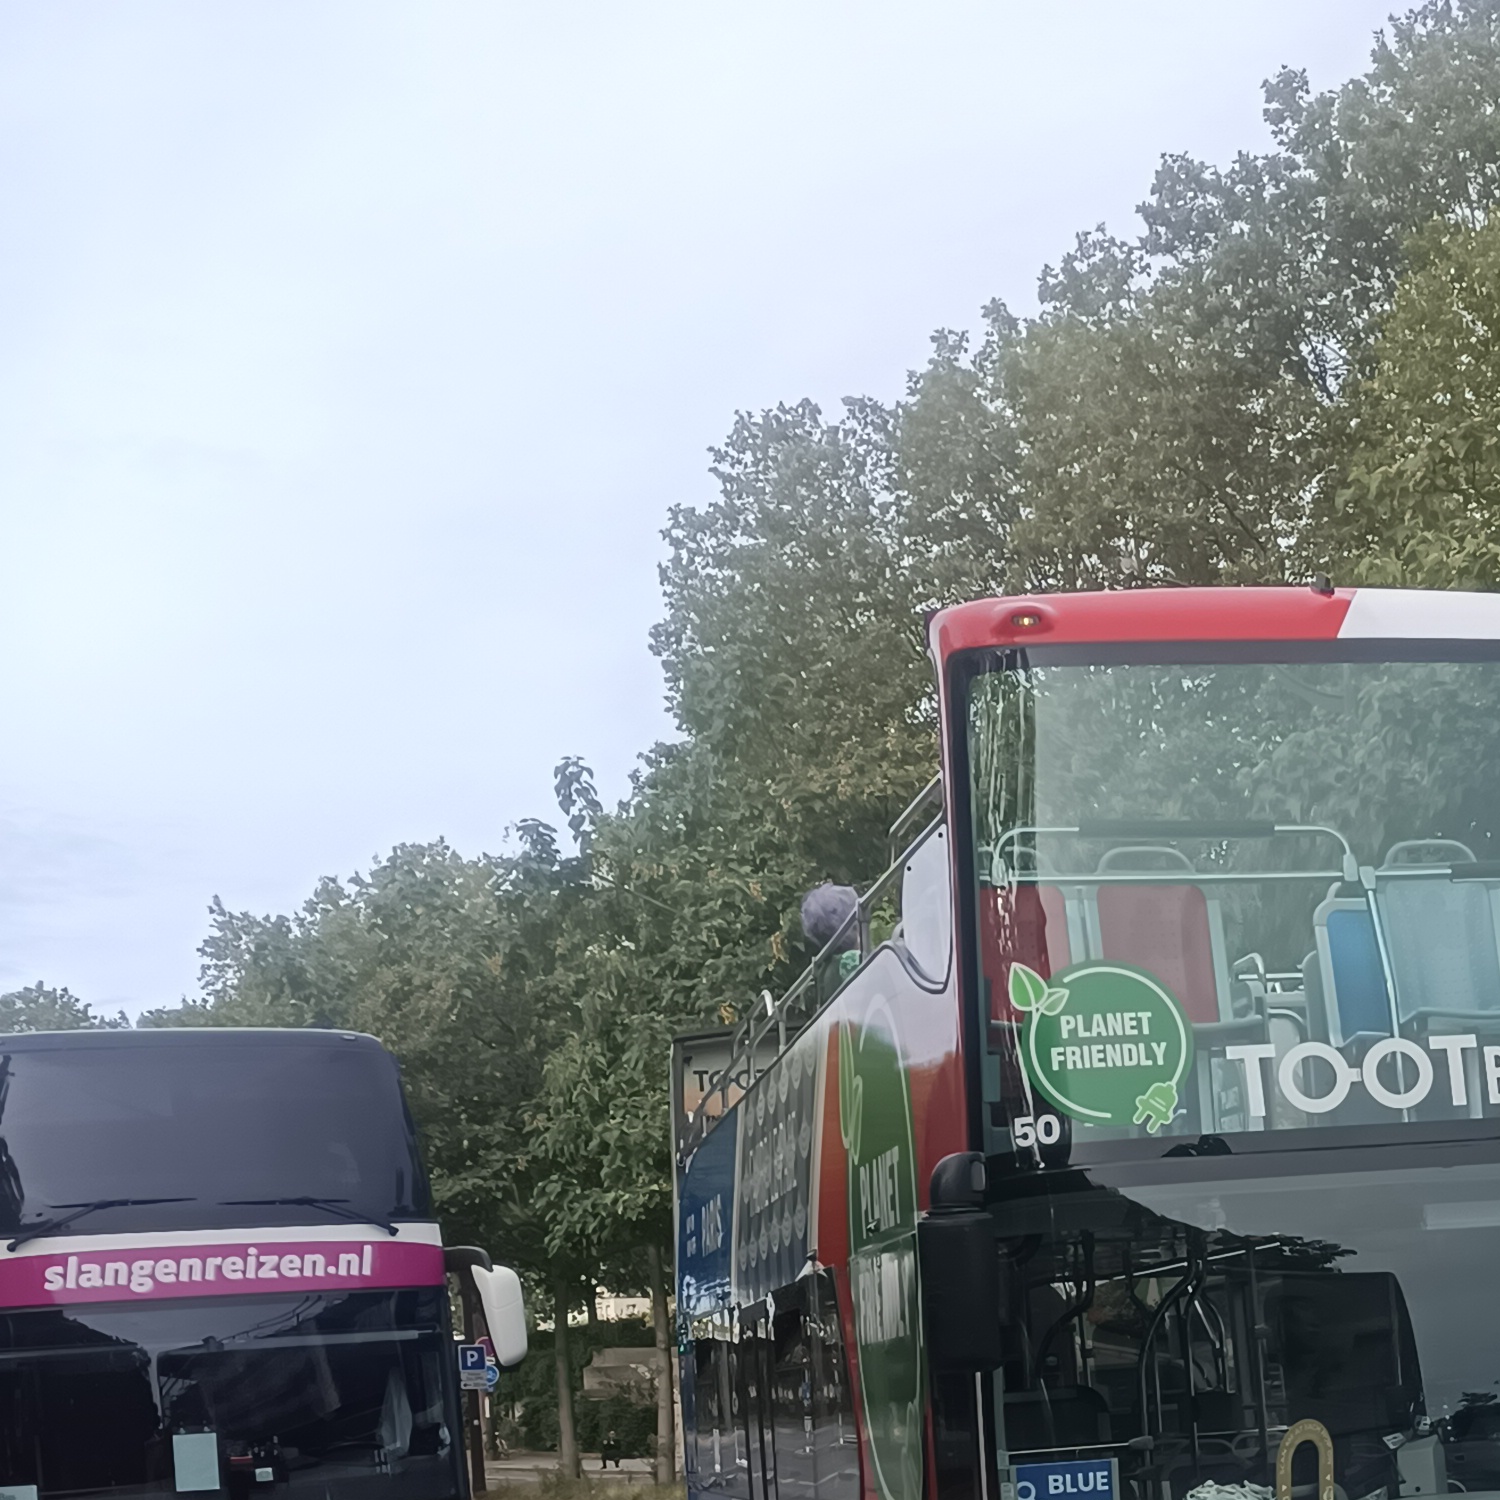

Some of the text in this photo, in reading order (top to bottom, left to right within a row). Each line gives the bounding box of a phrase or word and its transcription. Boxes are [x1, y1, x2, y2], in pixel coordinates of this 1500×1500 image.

[1059, 1011, 1152, 1039] PLANET
[1050, 1041, 1167, 1071] FRIENDLY
[1013, 1113, 1061, 1148] 50
[43, 1244, 373, 1293] slangenreizen.nl
[466, 1350, 479, 1367] P
[1048, 1470, 1110, 1495] BLUE
